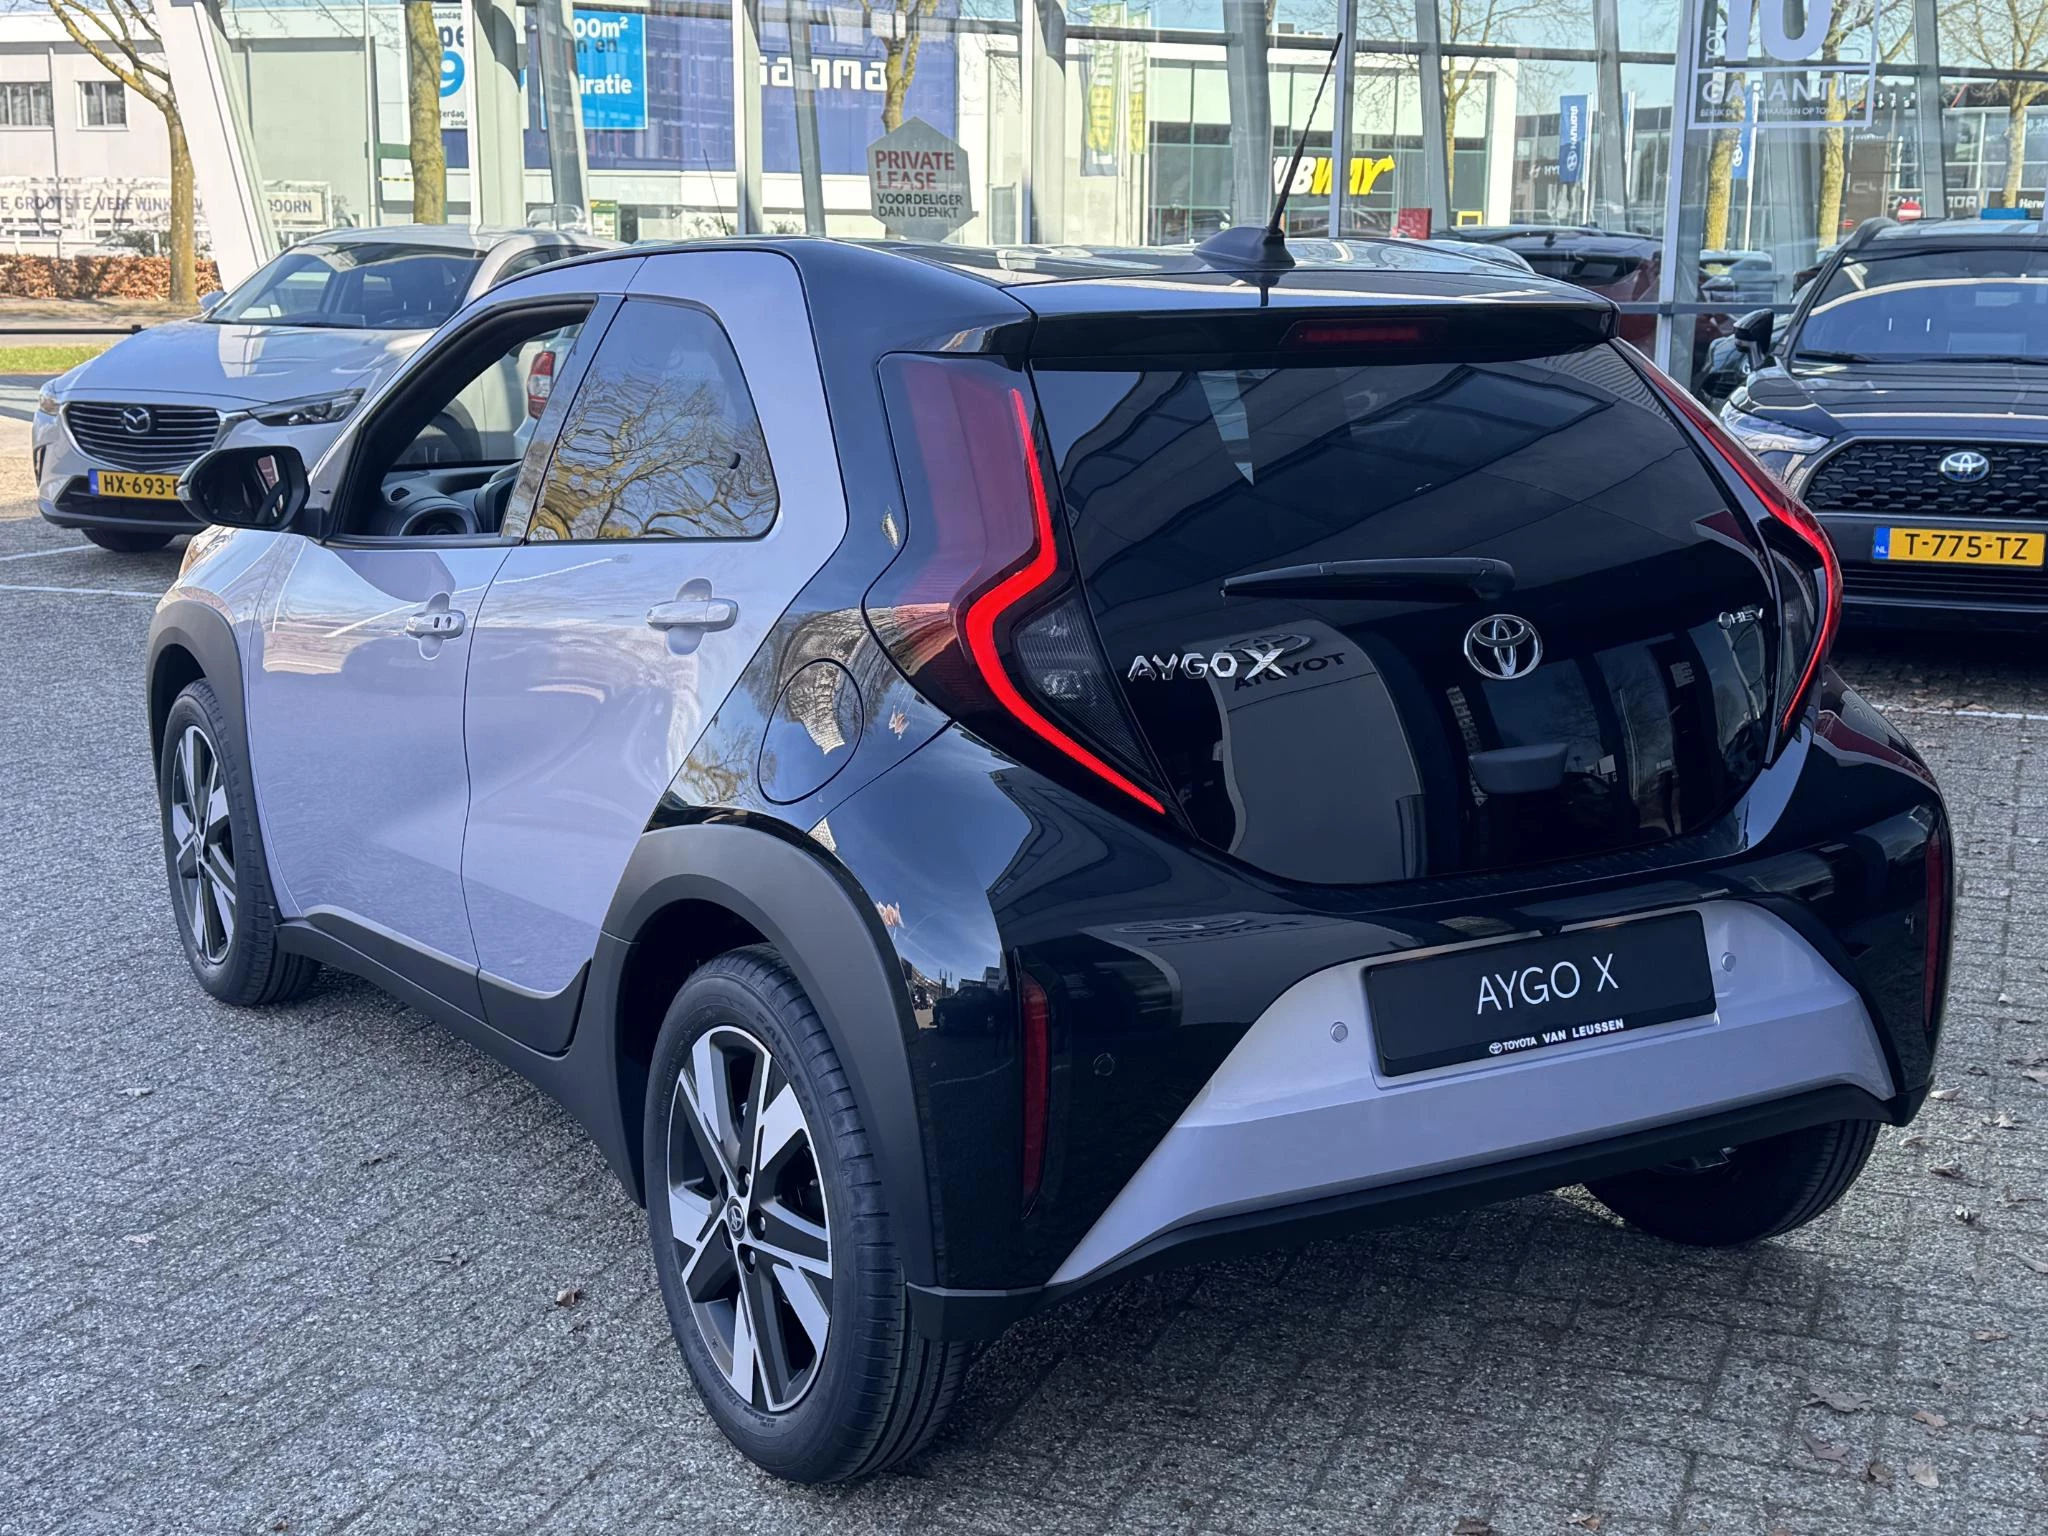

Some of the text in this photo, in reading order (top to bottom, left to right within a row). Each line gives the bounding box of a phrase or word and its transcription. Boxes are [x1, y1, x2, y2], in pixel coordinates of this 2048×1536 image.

[595, 38, 618, 53] en
[1704, 26, 1721, 62] TOT
[875, 150, 955, 171] PRIVATE
[876, 170, 936, 191] LEASE
[1273, 155, 1396, 195] UBWAY
[15, 195, 92, 212] GROOTSTE
[98, 195, 172, 212] VERFWINK
[877, 192, 963, 206] VOORDELIGER
[879, 206, 959, 219] DAN U DENKT
[1875, 545, 1887, 554] NL
[1905, 533, 2029, 560] T-775-TZ
[1128, 648, 1288, 682] AYGO X
[1477, 953, 1619, 1014] AYGO X
[1502, 1018, 1624, 1051] TOYOTA VAN LEUSSEN
